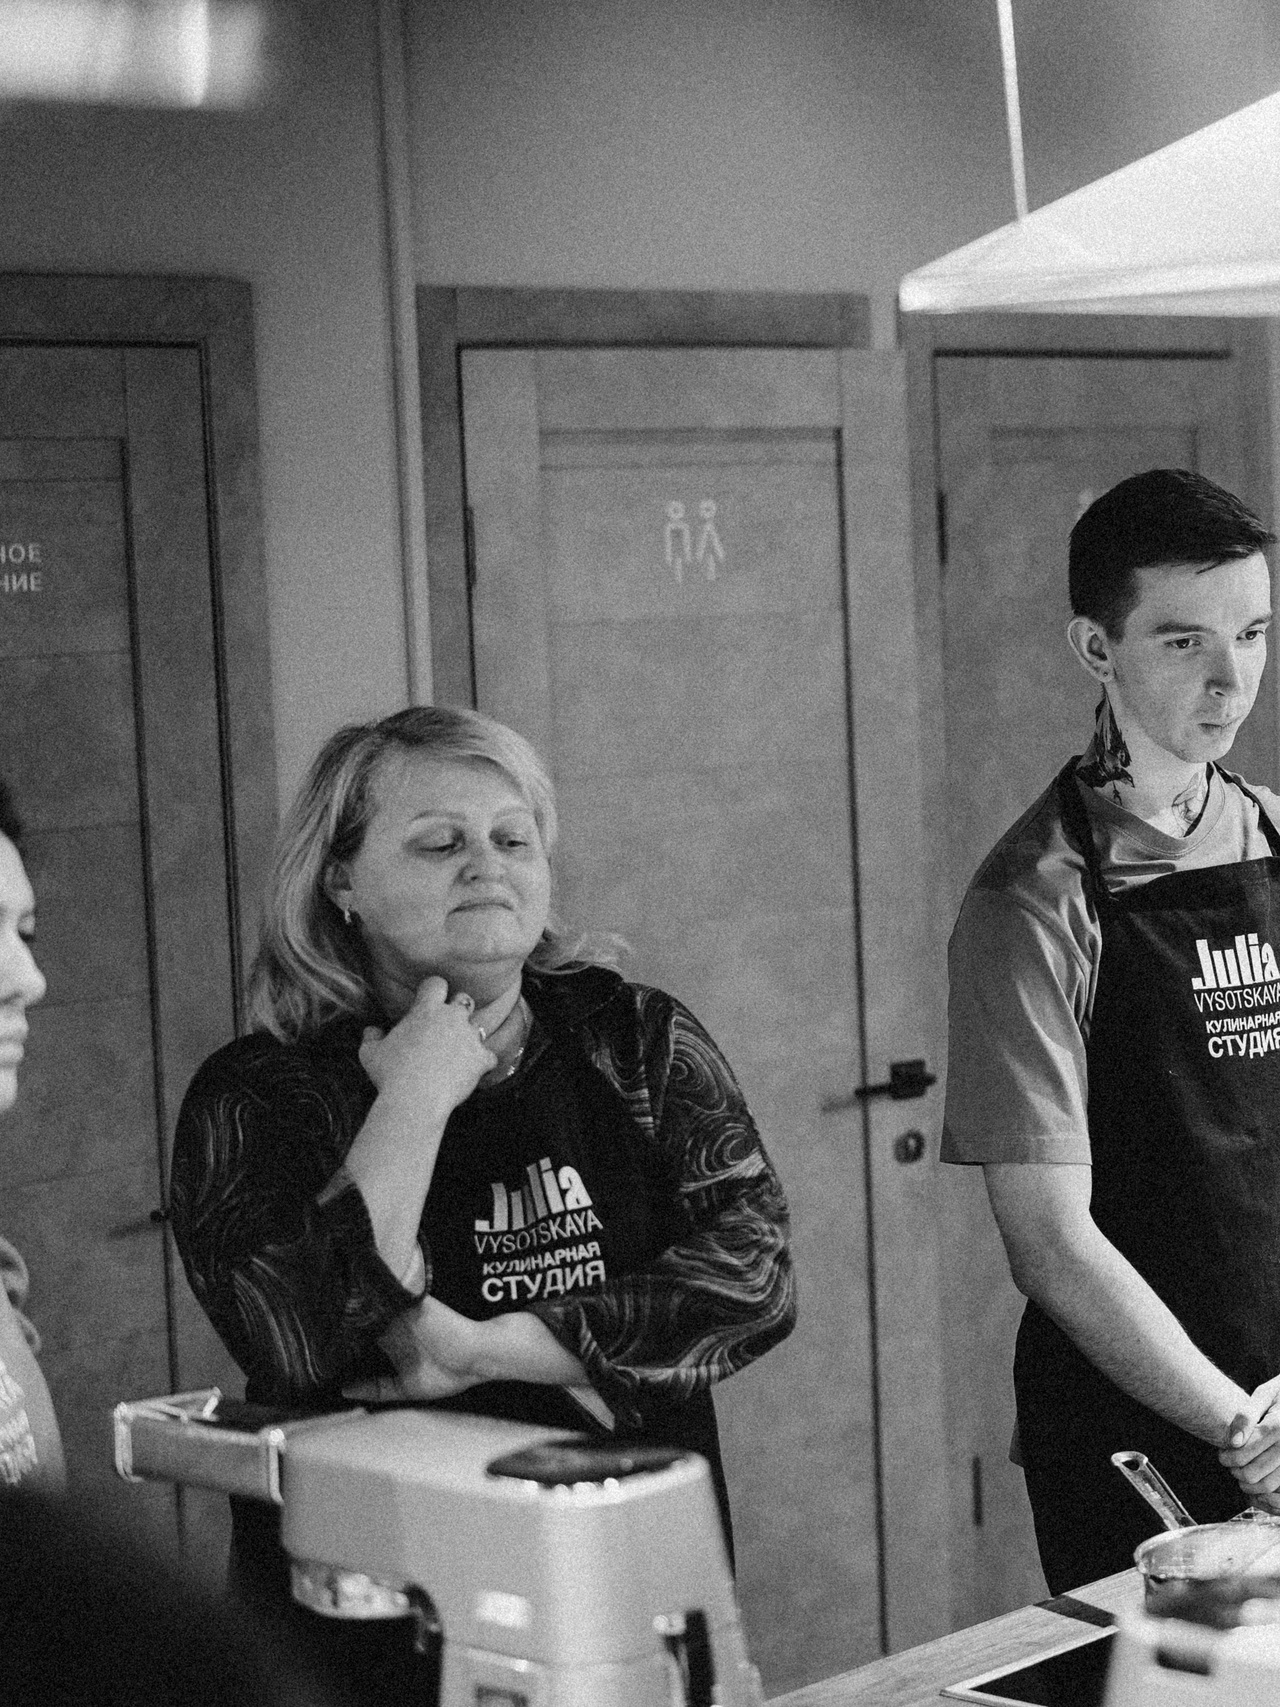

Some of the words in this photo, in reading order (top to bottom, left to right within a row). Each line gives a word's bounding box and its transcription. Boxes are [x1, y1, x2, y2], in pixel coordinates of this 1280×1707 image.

[1191, 933, 1280, 990] Julia
[475, 1157, 593, 1232] Julia
[474, 1209, 603, 1254] VYSOTSKAYA
[482, 1241, 601, 1275] КУЛИНАРНАЯ
[481, 1260, 606, 1302] СТУДИЯ
